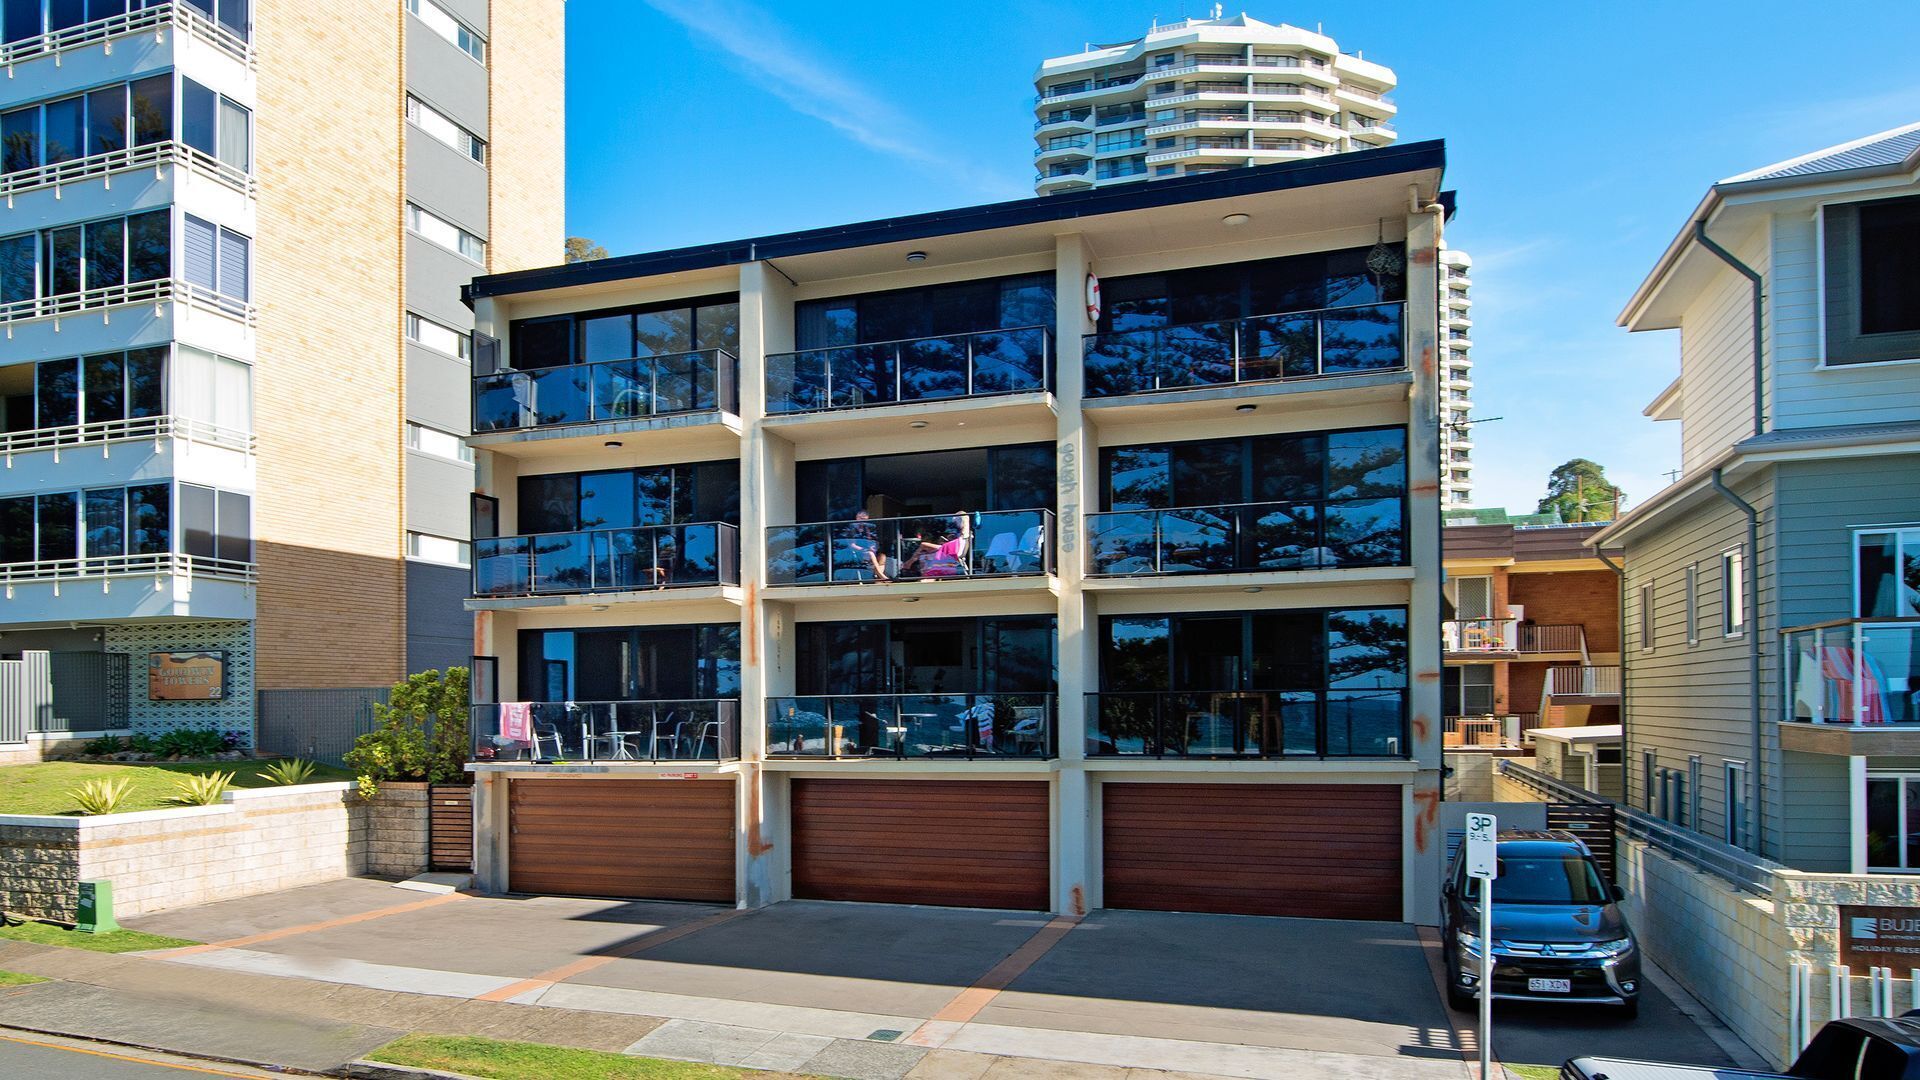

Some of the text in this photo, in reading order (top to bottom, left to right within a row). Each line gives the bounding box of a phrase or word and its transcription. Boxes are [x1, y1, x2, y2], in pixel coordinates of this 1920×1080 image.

[1061, 504, 1077, 552] house
[164, 677, 209, 685] TOWERS
[209, 687, 222, 698] 22
[1470, 817, 1492, 832] 3P
